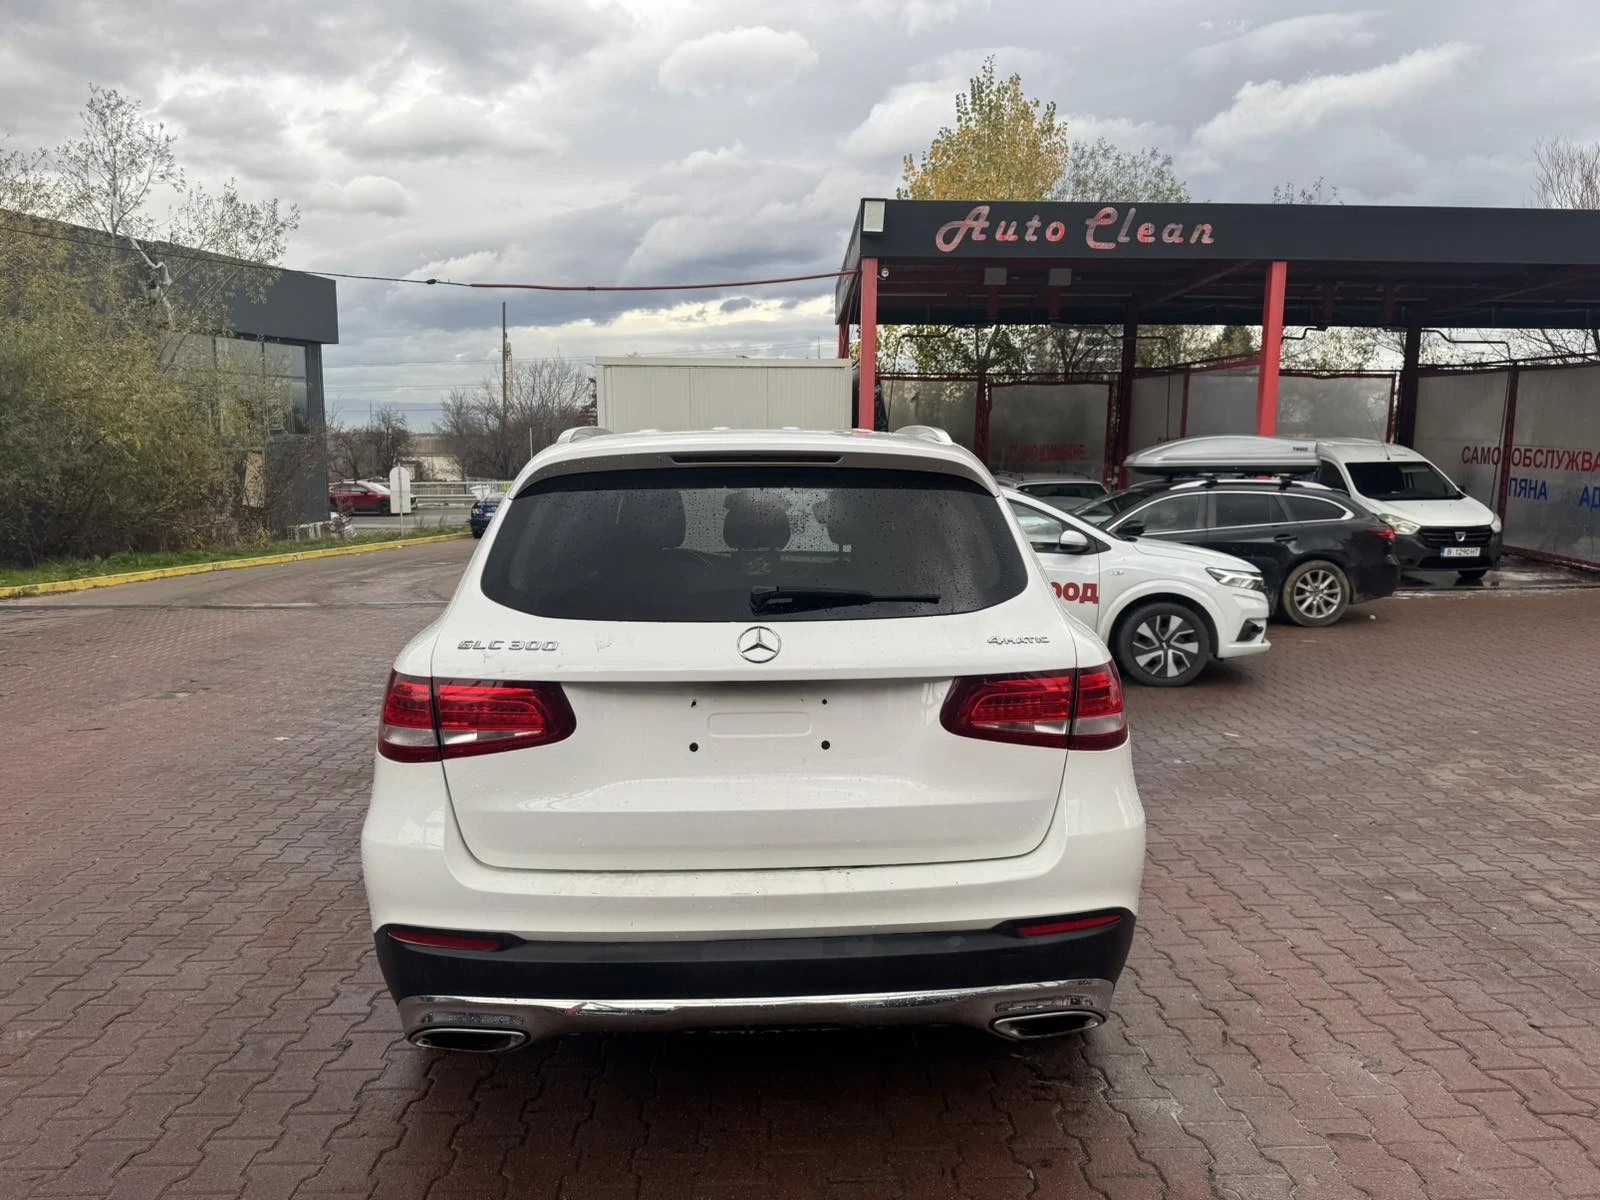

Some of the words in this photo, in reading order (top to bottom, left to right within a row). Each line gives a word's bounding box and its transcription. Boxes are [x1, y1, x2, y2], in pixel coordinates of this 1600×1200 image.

[935, 205, 1066, 252] Auto
[1085, 206, 1215, 249] Clean
[1461, 445, 1502, 465] САМО
[1508, 478, 1548, 500] ПЯНА
[457, 639, 504, 650] GLC
[508, 640, 559, 651] 300
